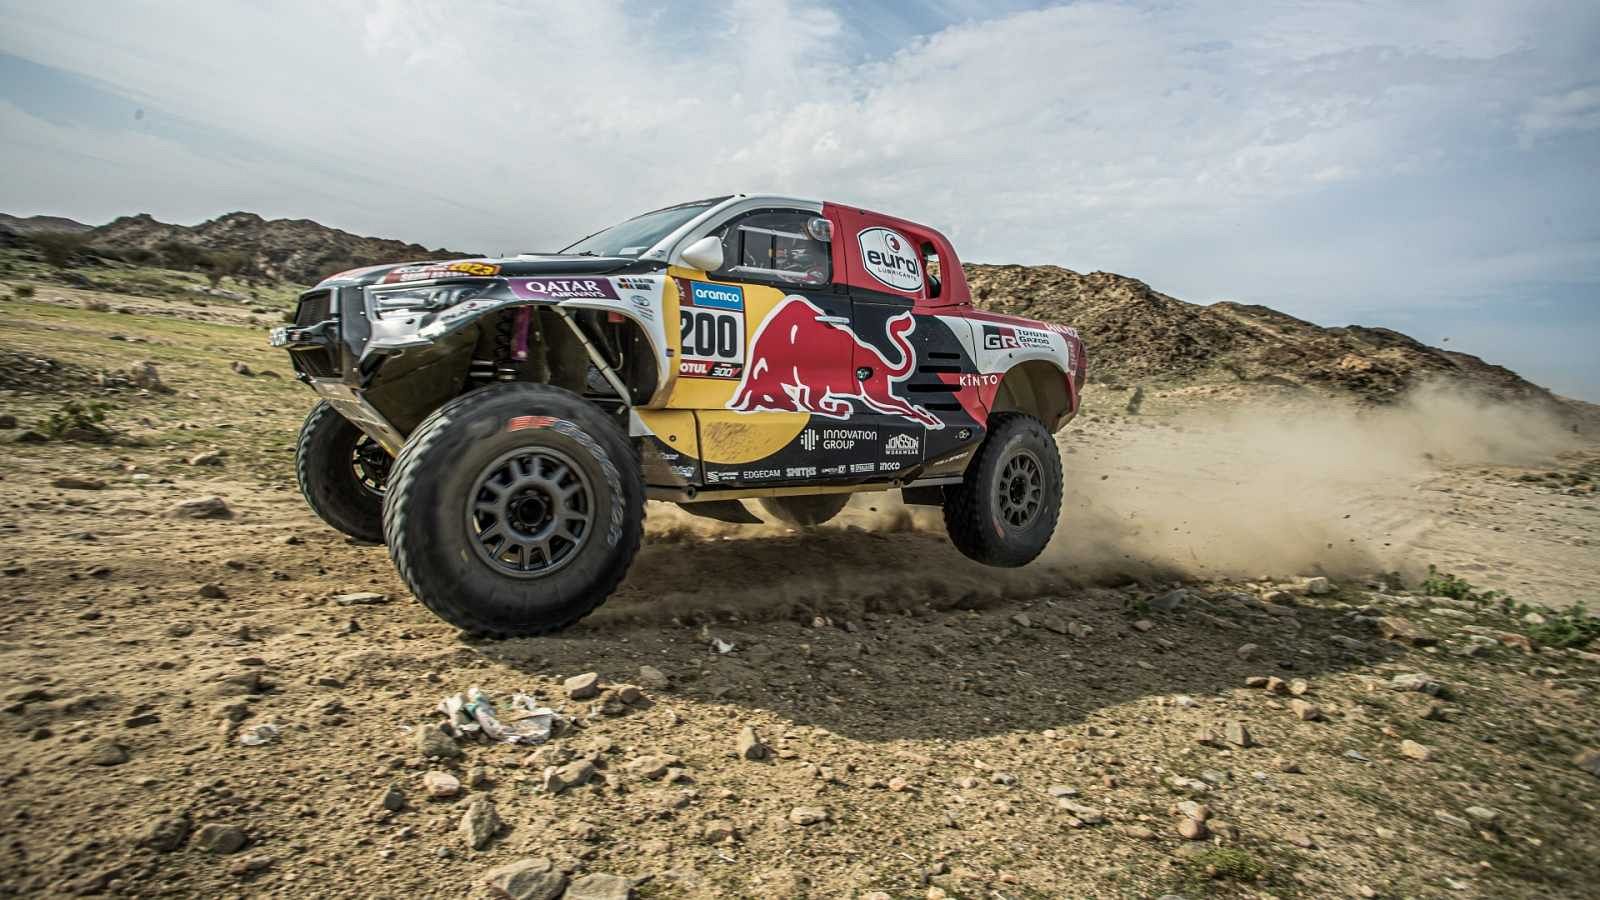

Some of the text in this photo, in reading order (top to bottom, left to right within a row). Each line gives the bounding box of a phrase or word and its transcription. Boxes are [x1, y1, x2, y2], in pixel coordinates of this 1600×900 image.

[449, 262, 495, 275] 2023
[867, 250, 919, 278] eurol
[525, 280, 601, 293] QATAR
[695, 289, 739, 302] aramco
[680, 310, 737, 358] 200
[985, 334, 1021, 349] GR
[680, 363, 708, 374] OTUL
[823, 429, 877, 441] INNOVATION
[885, 433, 919, 449] JONSSON
[823, 440, 855, 450] GROUP
[743, 469, 781, 479] EDGECAM
